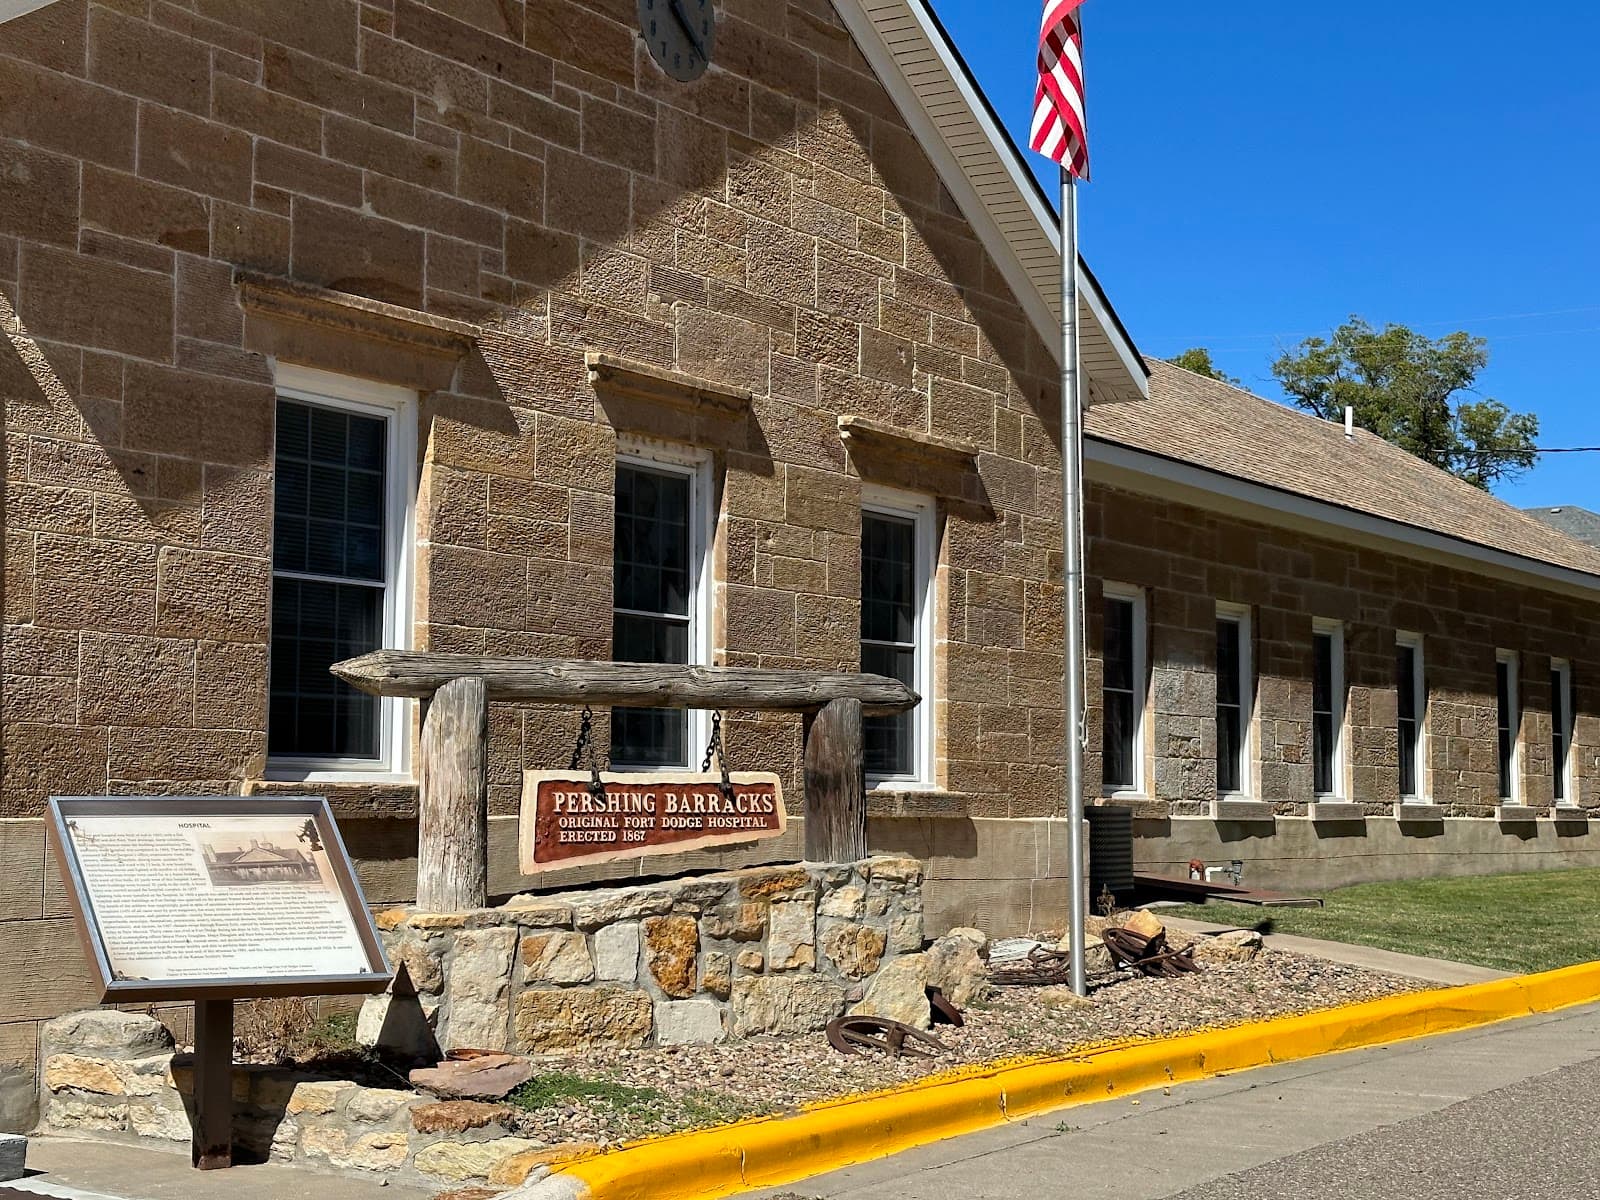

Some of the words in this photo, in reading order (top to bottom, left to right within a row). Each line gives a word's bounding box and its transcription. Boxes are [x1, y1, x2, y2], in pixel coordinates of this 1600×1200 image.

[552, 791, 656, 813] PERSHING
[664, 792, 774, 814] BARRACKS
[559, 816, 618, 828] ORIGINAL
[624, 816, 656, 828] FORT
[661, 816, 703, 828] DODGE
[708, 815, 768, 828] HOSPITAL
[559, 831, 617, 843] ERECTED
[622, 831, 646, 843] 1867
